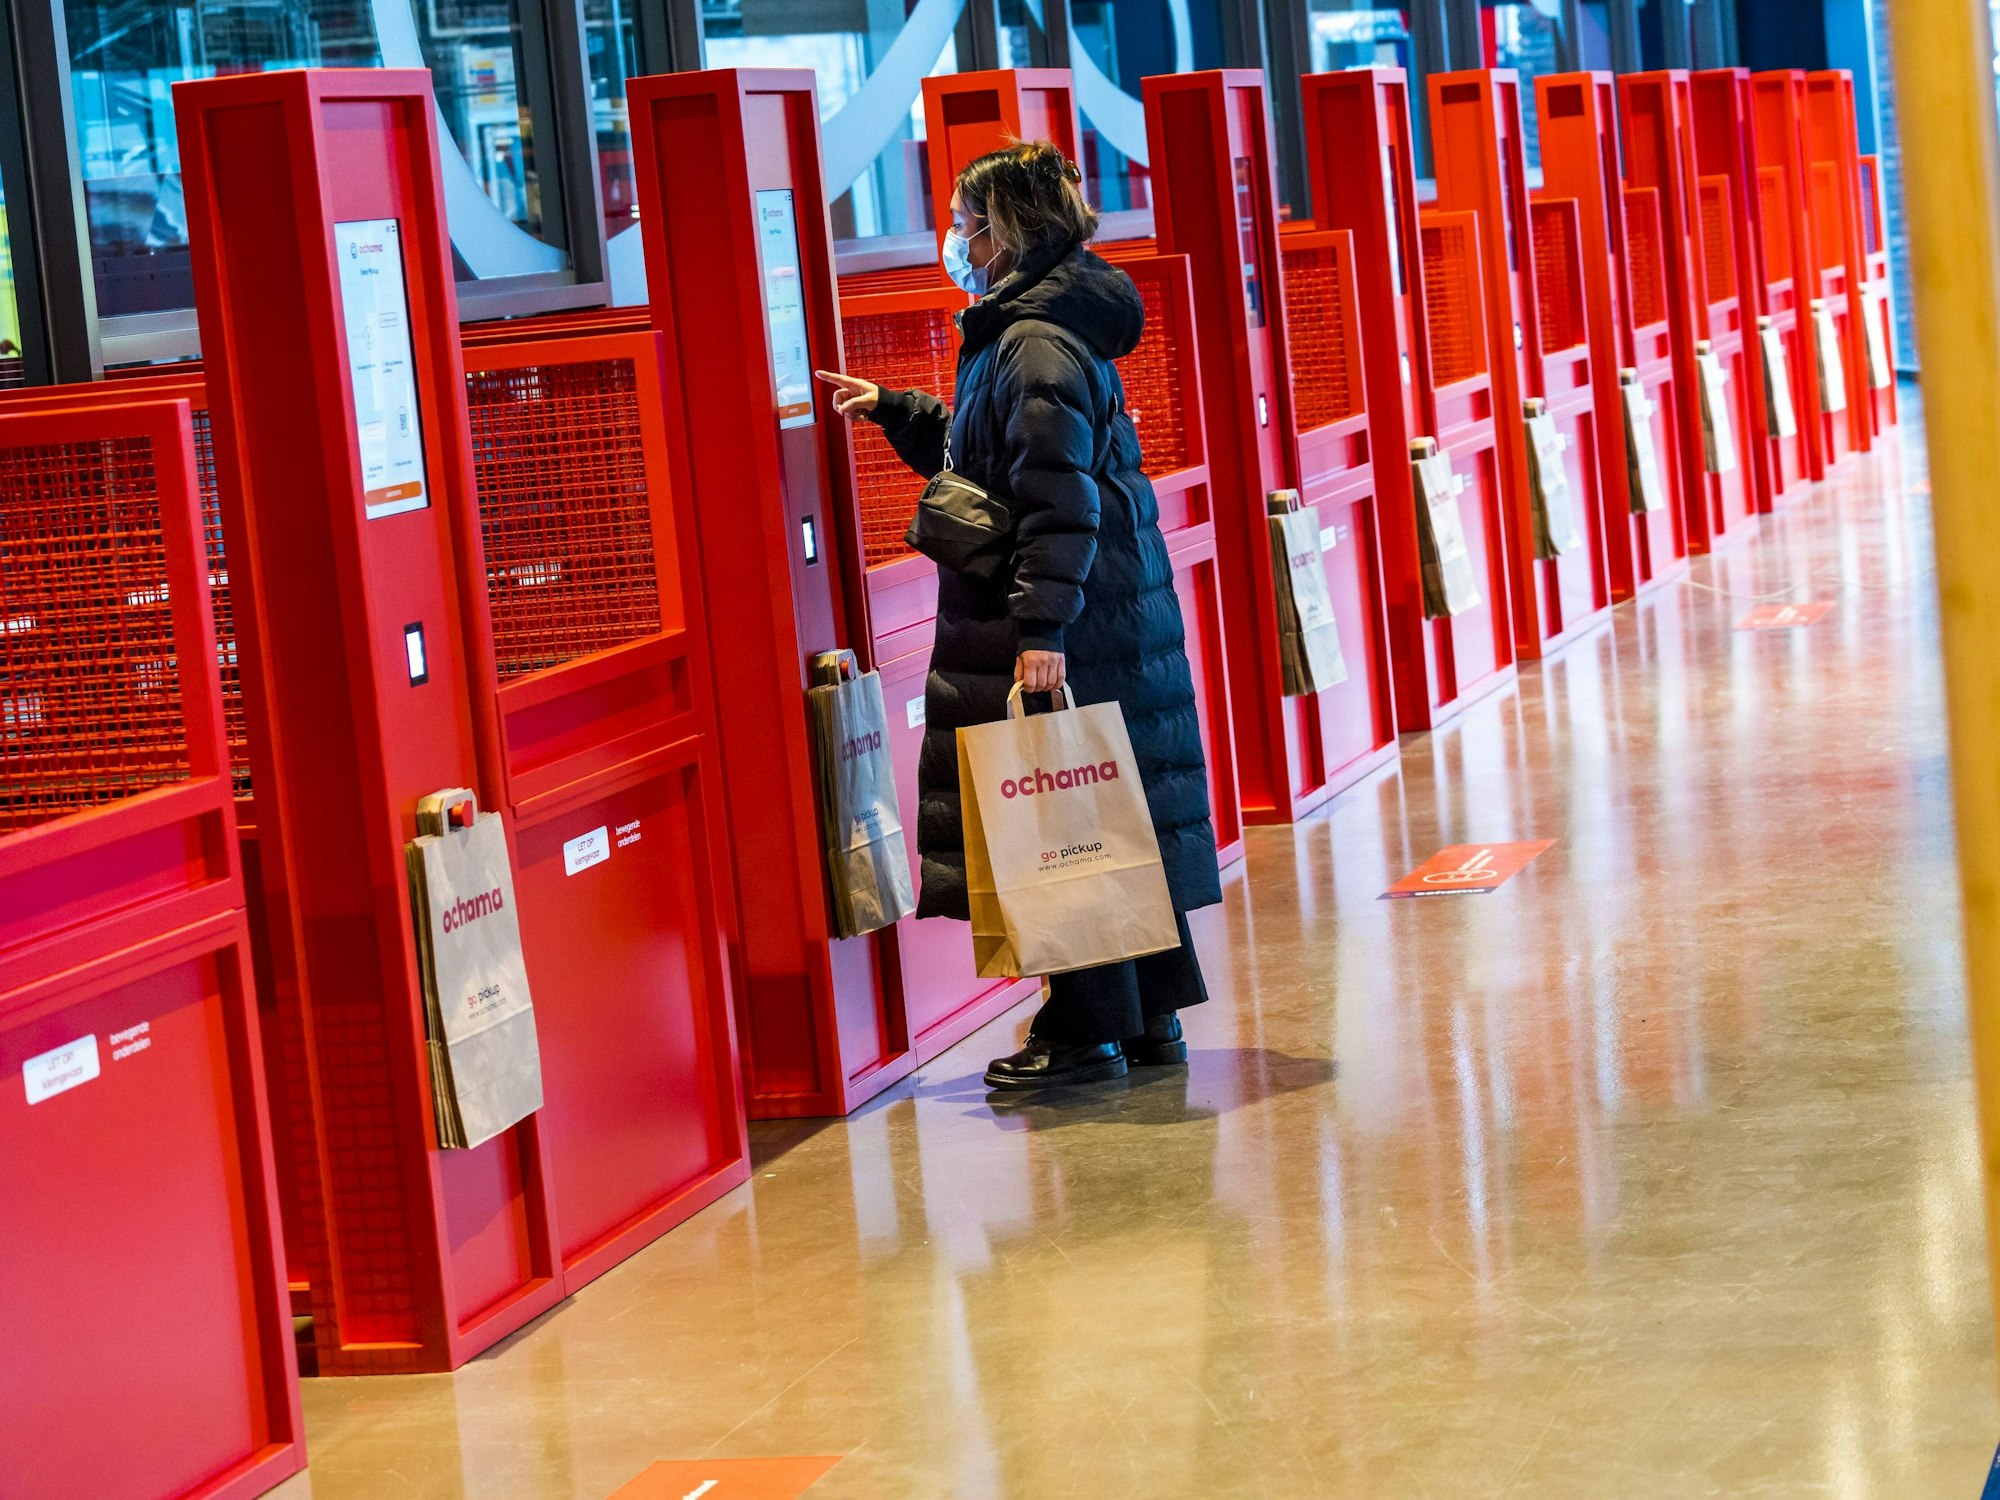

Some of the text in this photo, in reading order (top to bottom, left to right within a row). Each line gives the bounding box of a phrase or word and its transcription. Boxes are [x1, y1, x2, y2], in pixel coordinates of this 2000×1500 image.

[1001, 761, 1119, 799] ochama
[861, 808, 879, 822] pickup
[1037, 853, 1112, 872] www.ochama.com
[1041, 842, 1103, 862] go pickup
[443, 887, 504, 934] ochama
[467, 984, 500, 1009] go pickup
